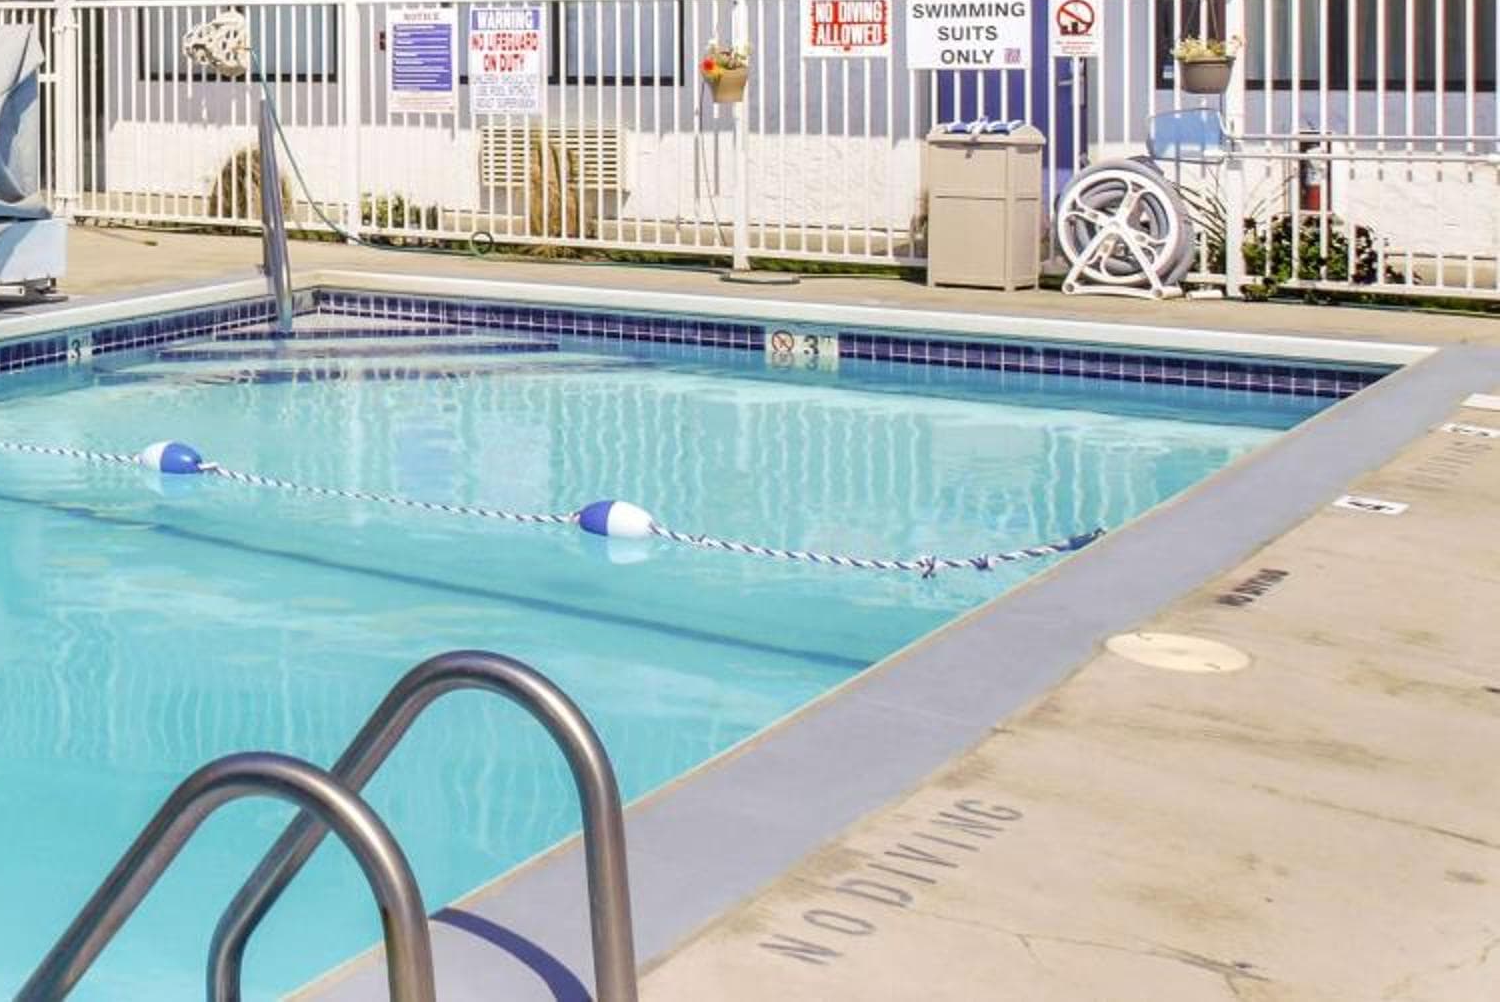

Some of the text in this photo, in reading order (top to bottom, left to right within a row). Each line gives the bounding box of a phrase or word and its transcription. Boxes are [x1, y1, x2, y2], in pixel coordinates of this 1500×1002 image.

[815, 1, 882, 23] NO DIVING
[911, 2, 1026, 19] SWIMMING
[477, 11, 533, 30] WARNING
[472, 32, 539, 51] NO LIFEGUARD
[816, 23, 882, 45] ALLOWED
[937, 26, 998, 42] SUITS
[483, 54, 525, 72] ON DUTY
[940, 49, 994, 65] ONLY
[803, 334, 820, 355] 3
[757, 799, 1024, 966] NO DIVING
